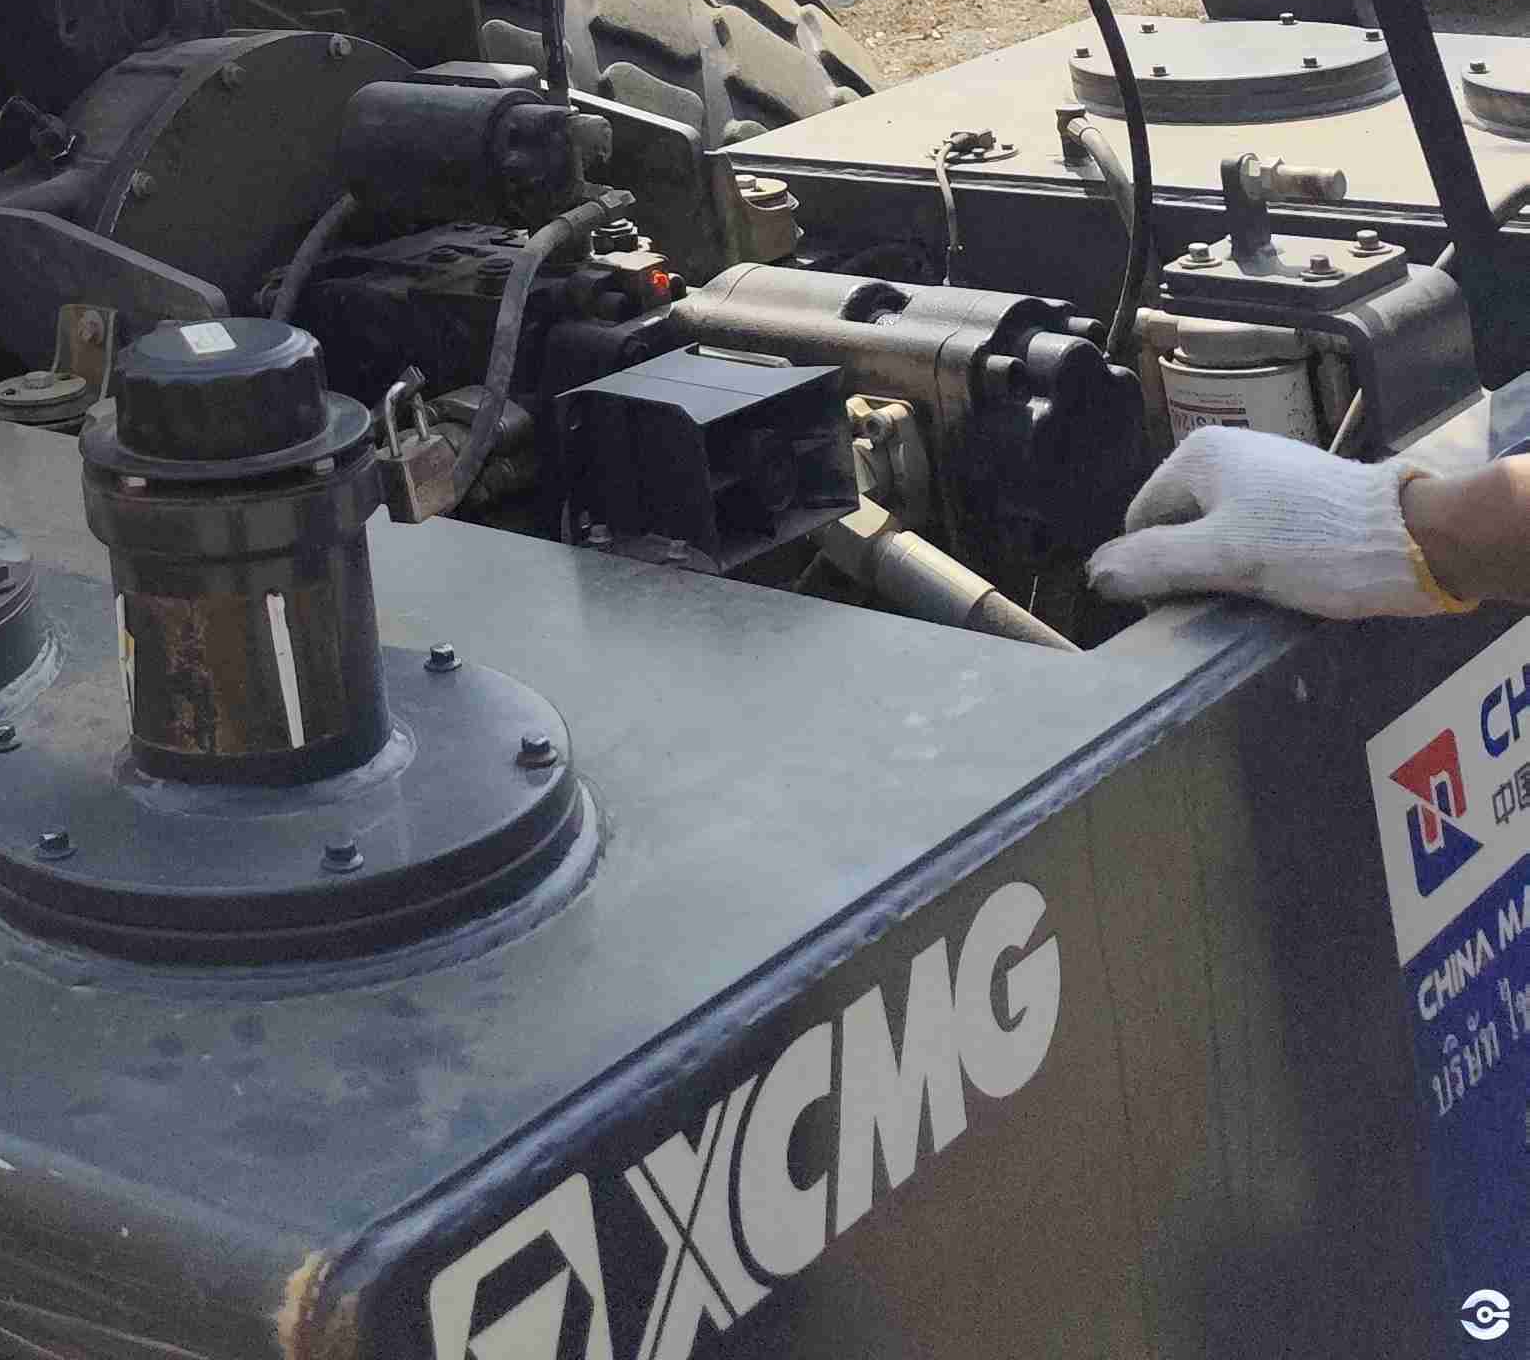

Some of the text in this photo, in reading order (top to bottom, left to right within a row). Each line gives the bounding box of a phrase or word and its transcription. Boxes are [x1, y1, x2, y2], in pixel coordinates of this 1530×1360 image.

[1418, 929, 1495, 1021] CHINA
[1431, 1010, 1501, 1117] บริษัท
[625, 882, 1062, 1360] XCMG
